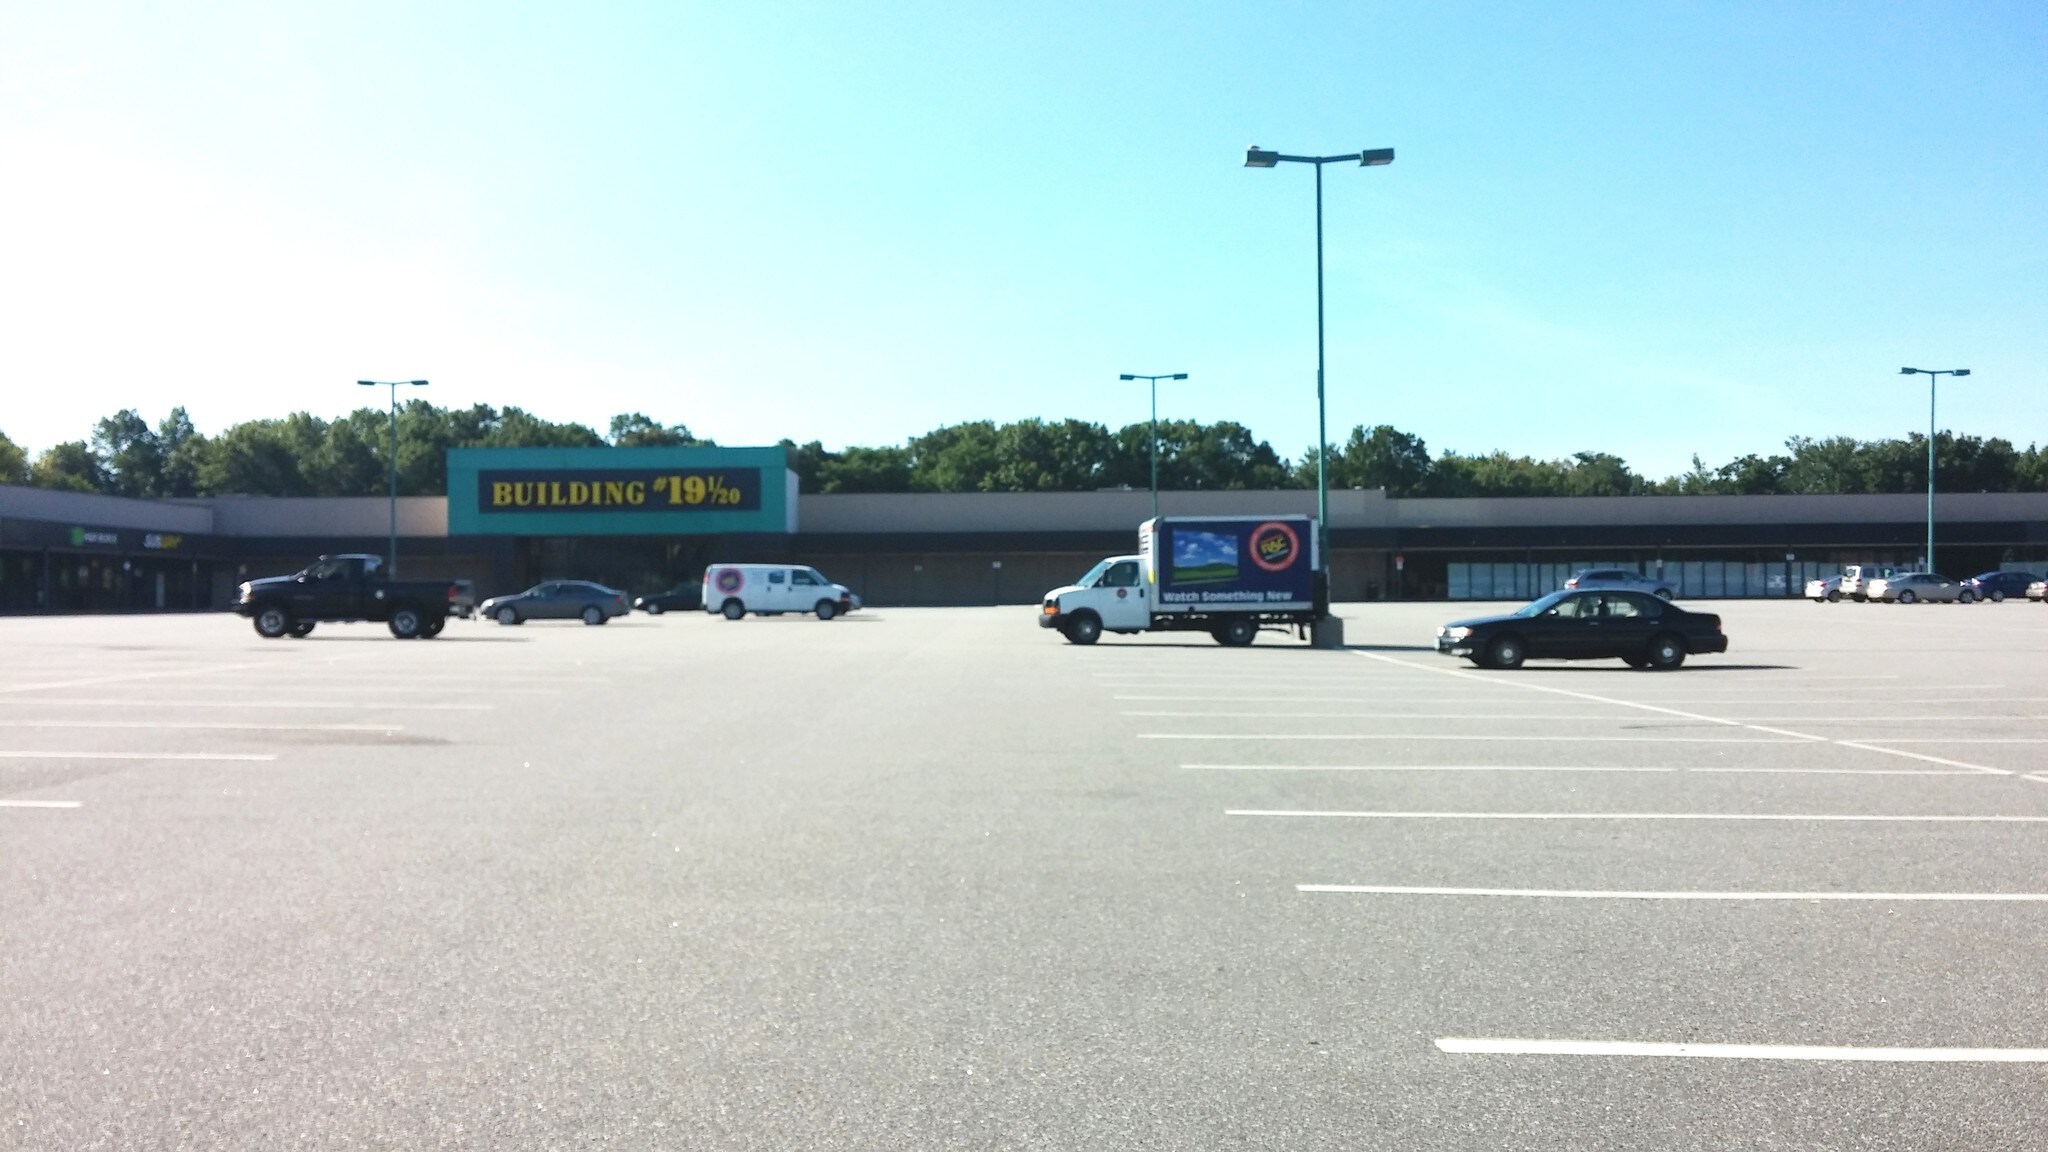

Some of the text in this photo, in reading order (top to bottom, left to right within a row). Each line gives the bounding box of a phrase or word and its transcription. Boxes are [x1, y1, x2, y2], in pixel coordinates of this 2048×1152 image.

[493, 481, 645, 505] BUILDING
[1163, 591, 1293, 603] Watch Something New
